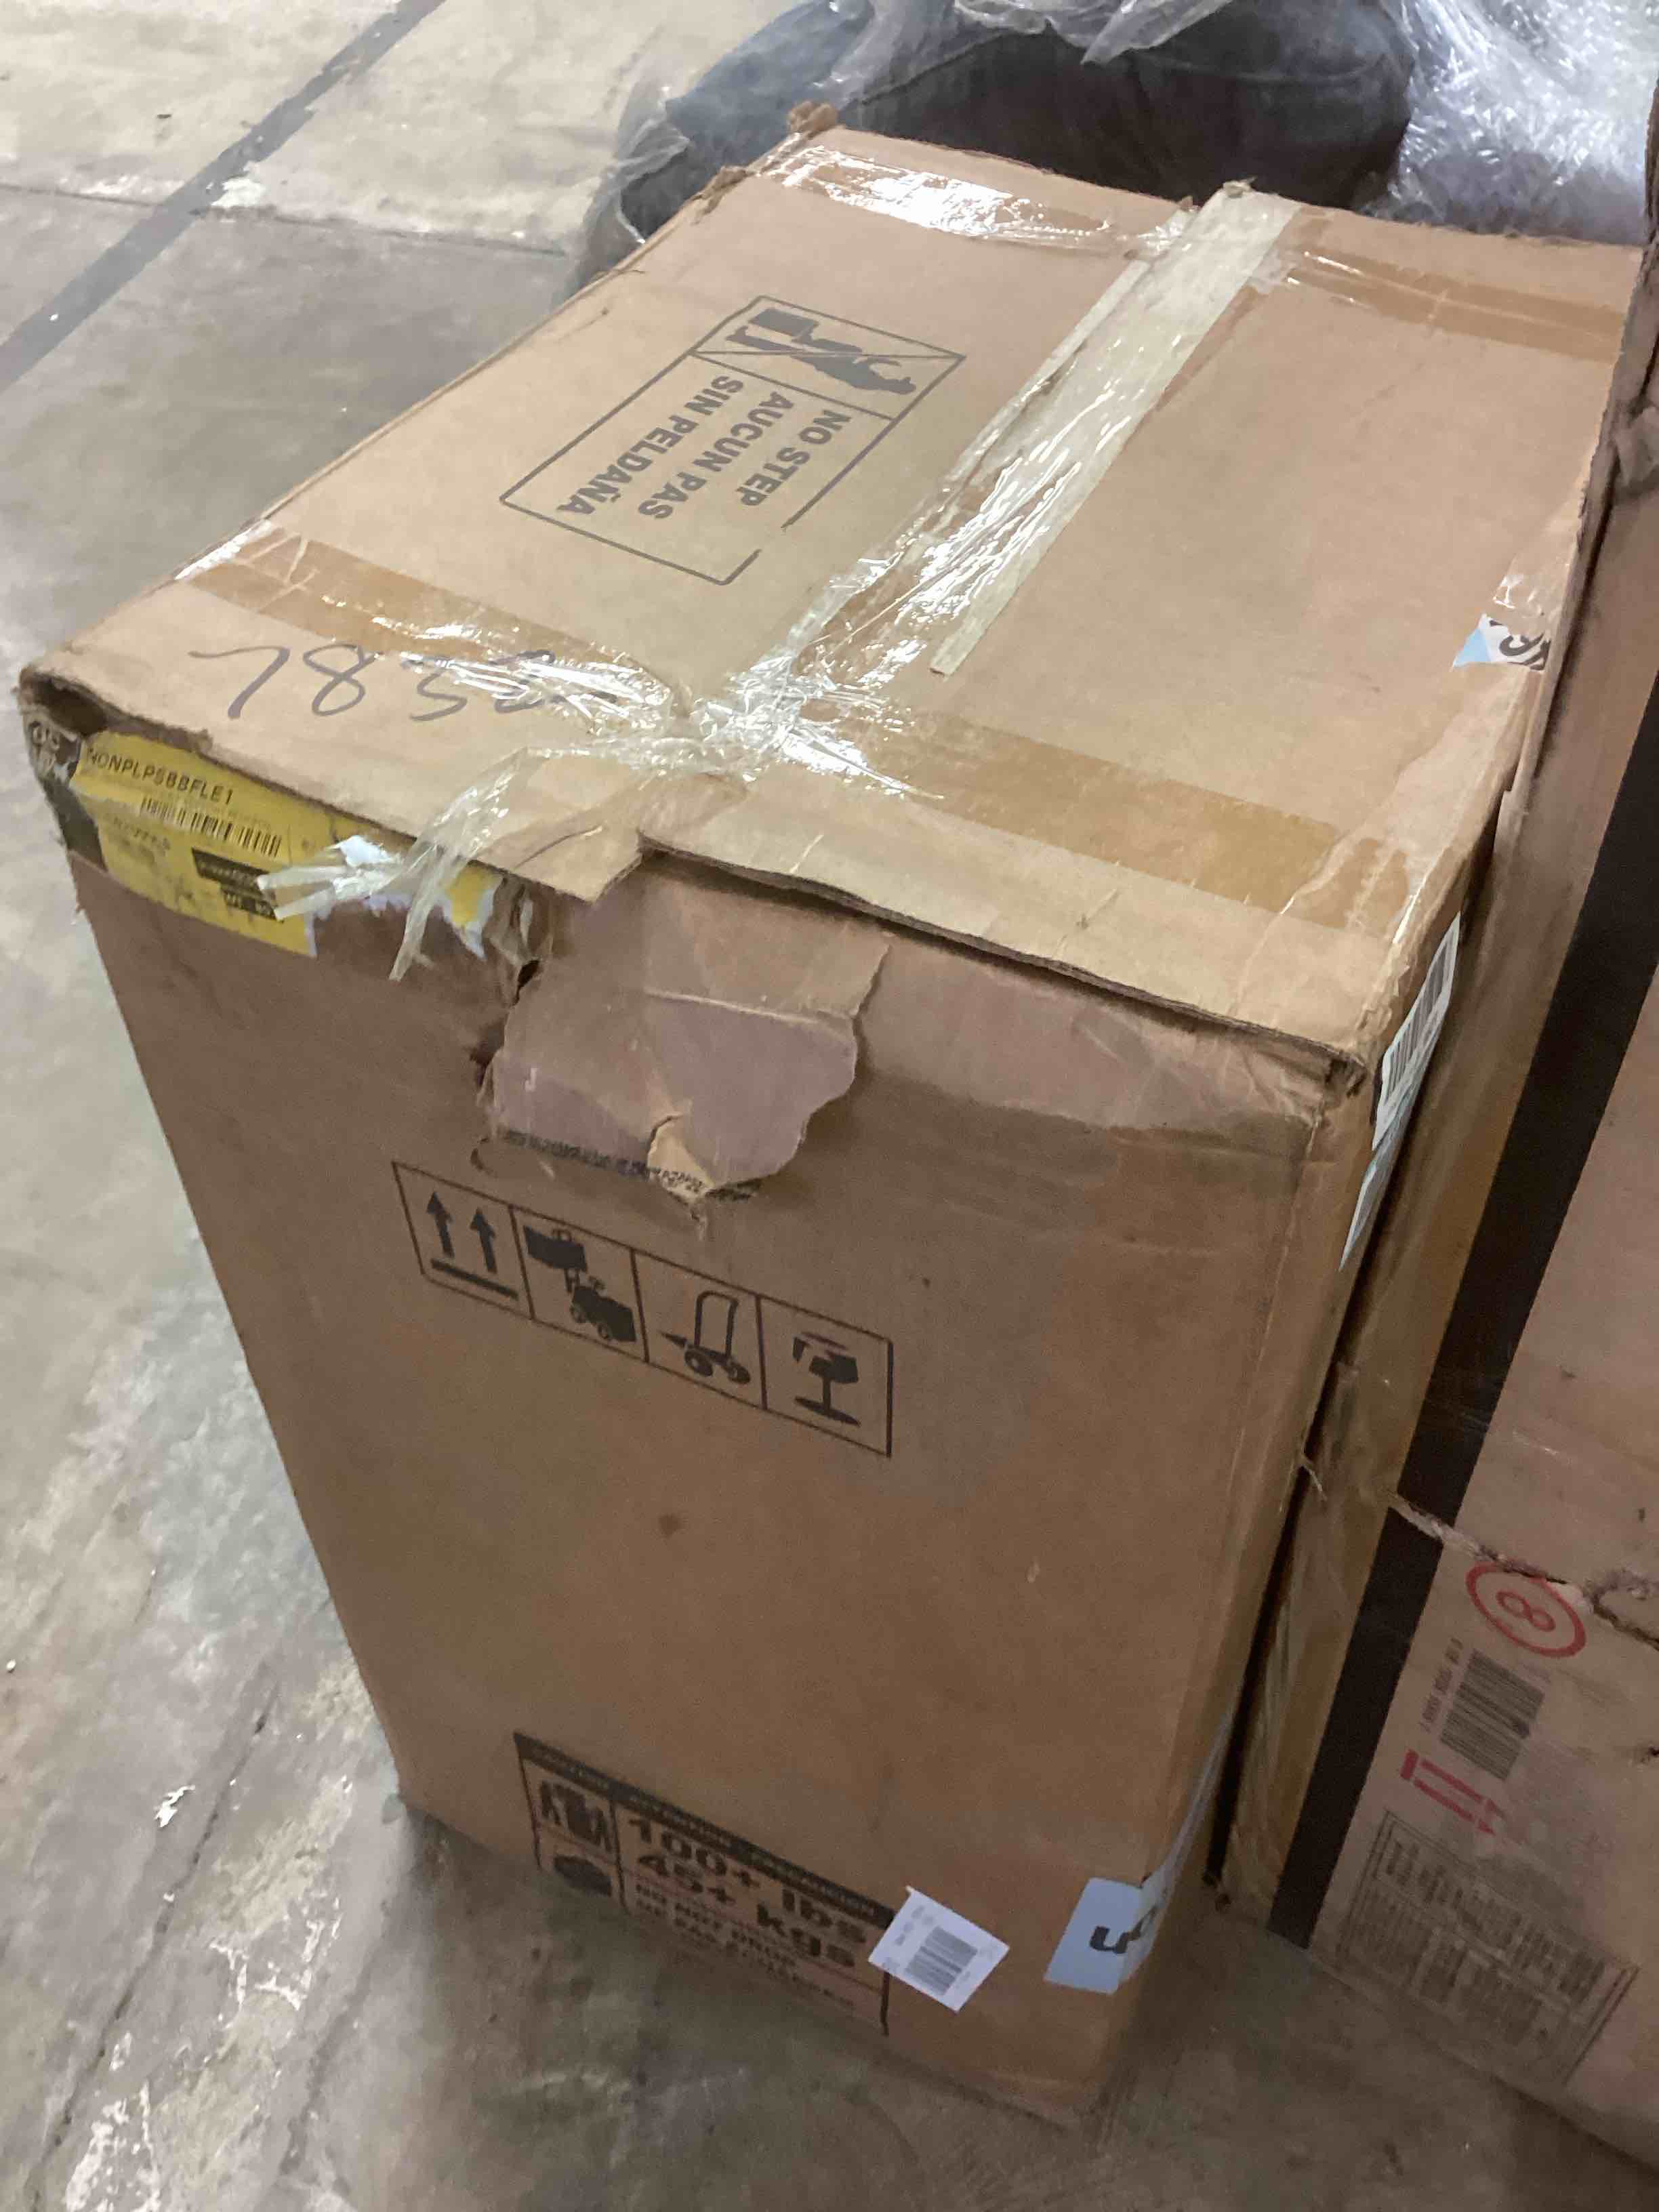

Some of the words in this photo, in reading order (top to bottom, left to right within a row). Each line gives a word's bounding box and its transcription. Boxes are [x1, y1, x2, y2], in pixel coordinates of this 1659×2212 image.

[684, 375, 743, 416] SIN
[692, 391, 794, 472] AUCUN
[798, 409, 851, 445] NO
[556, 415, 699, 515] PELDAÑA
[735, 447, 811, 506] STEP
[638, 471, 707, 519] PAS
